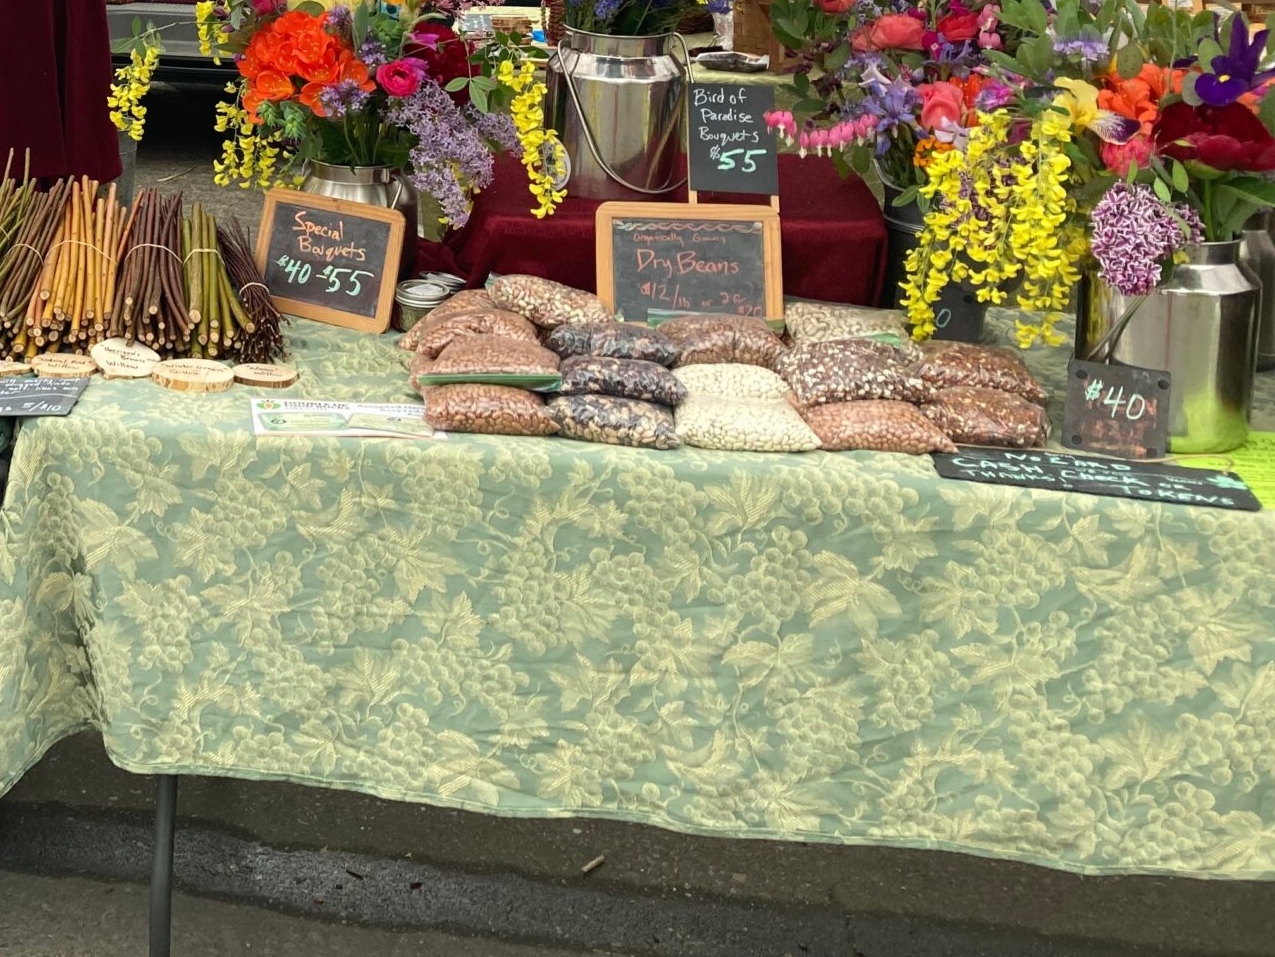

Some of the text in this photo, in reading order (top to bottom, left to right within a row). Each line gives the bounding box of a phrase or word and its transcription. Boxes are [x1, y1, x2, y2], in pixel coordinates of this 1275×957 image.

[693, 87, 747, 107] Bird of
[700, 108, 753, 123] Paradise
[698, 126, 759, 146] Bouquets
[709, 144, 767, 172] $55
[293, 211, 343, 241] Special
[297, 235, 366, 262] Bouquets
[633, 232, 726, 247] Organically Grown
[636, 248, 739, 278] Dry Beans
[951, 457, 1044, 474] CASH
